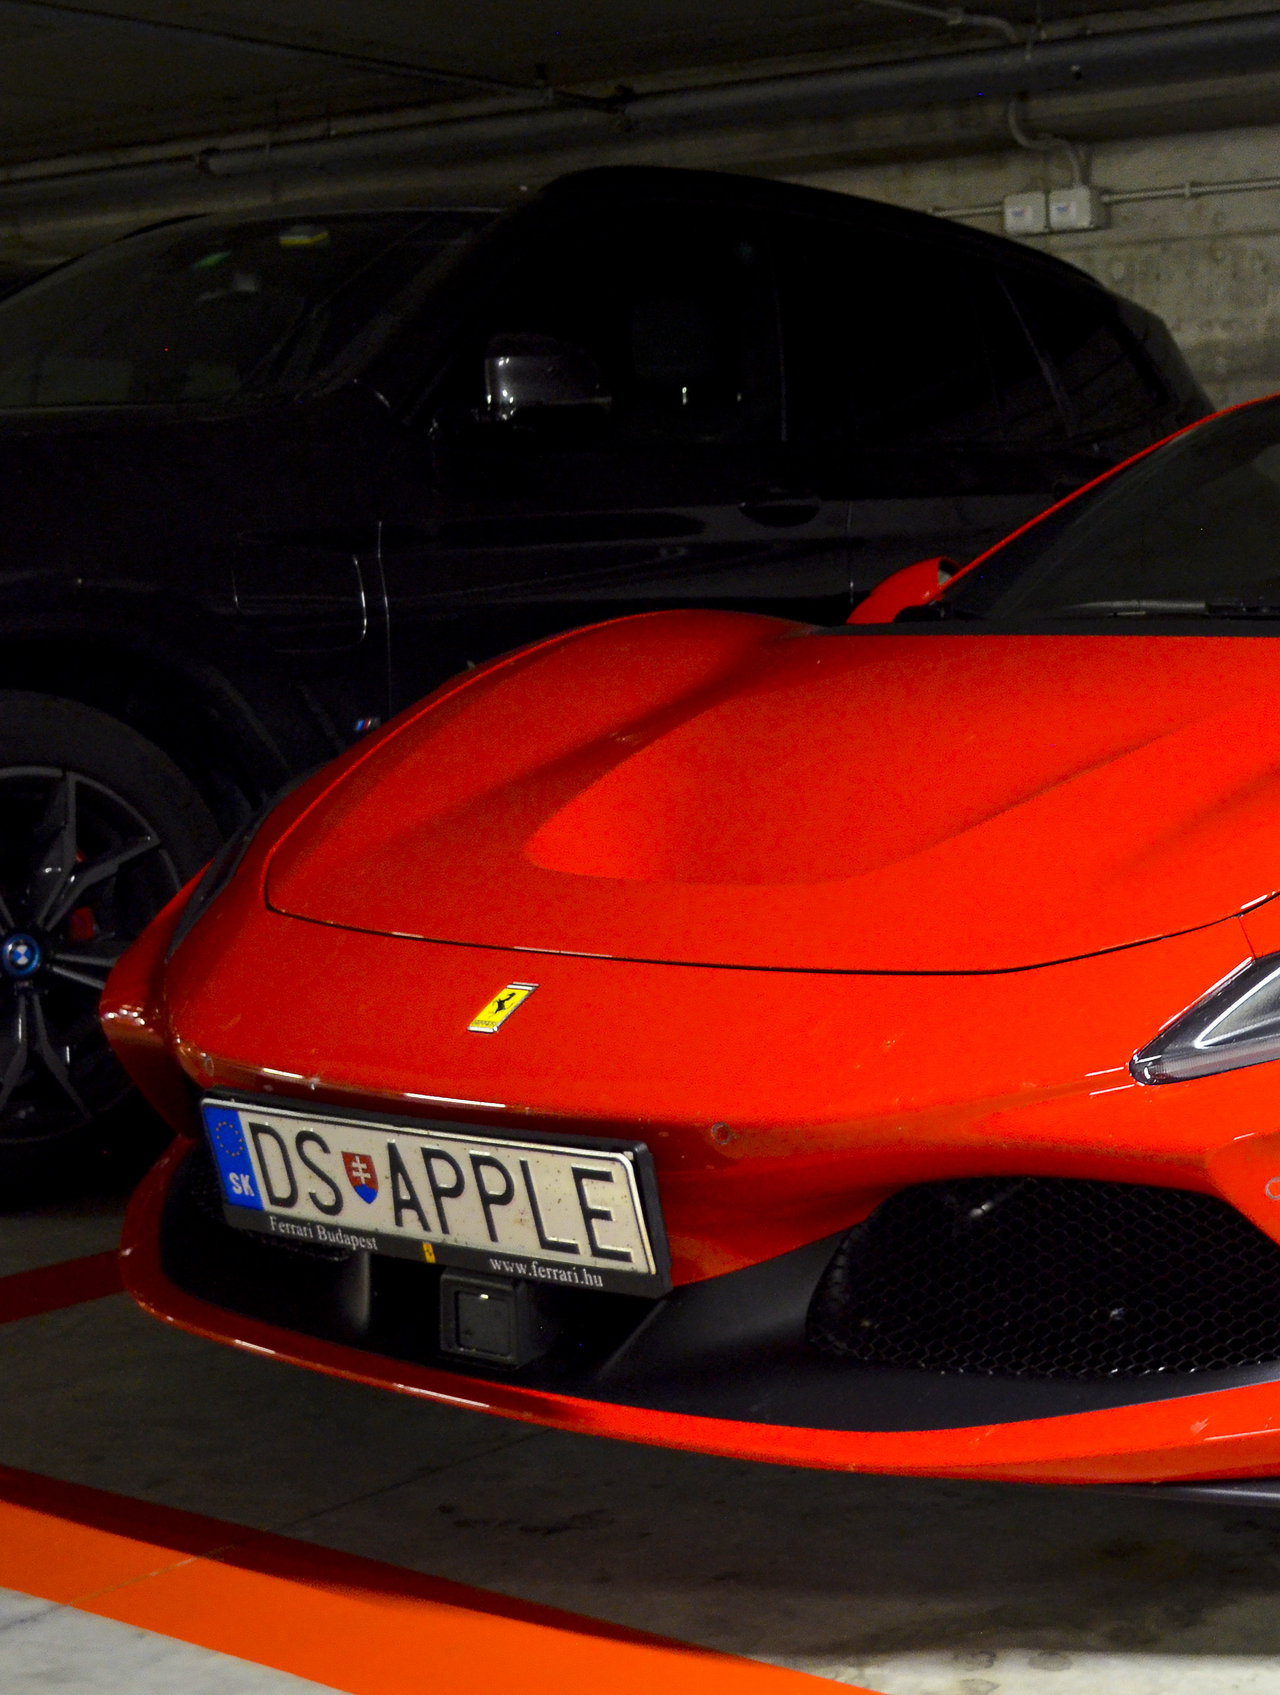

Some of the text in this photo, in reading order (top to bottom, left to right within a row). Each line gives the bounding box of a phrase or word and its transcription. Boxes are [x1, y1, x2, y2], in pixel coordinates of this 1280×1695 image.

[228, 1171, 256, 1198] SK
[248, 1121, 634, 1264] DS APPLE
[269, 1215, 379, 1251] Ferrari Budapest
[489, 1258, 604, 1288] www.ferrari.hu
